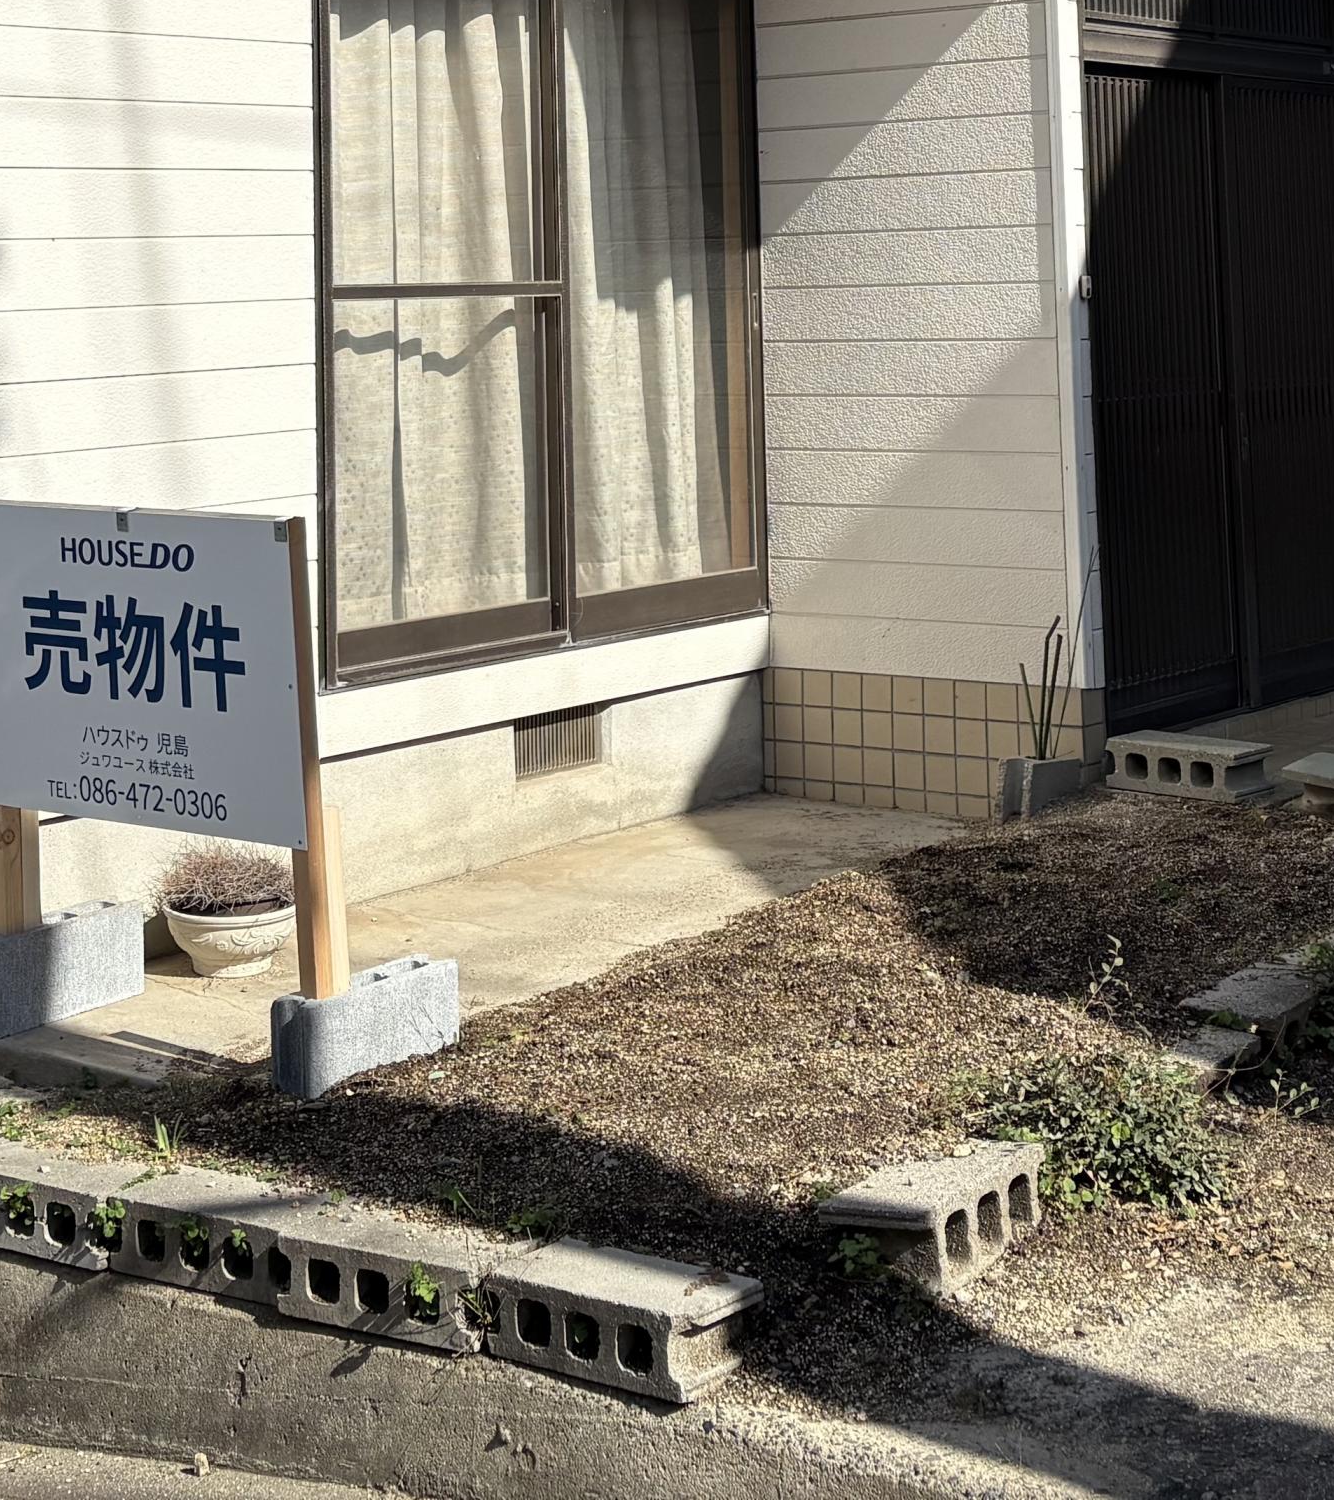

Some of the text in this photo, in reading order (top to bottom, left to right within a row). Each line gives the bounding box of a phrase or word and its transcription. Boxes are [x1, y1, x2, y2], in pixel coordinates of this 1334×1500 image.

[22, 589, 246, 713] 売物件
[82, 725, 189, 758] ハウスドゥ 児島
